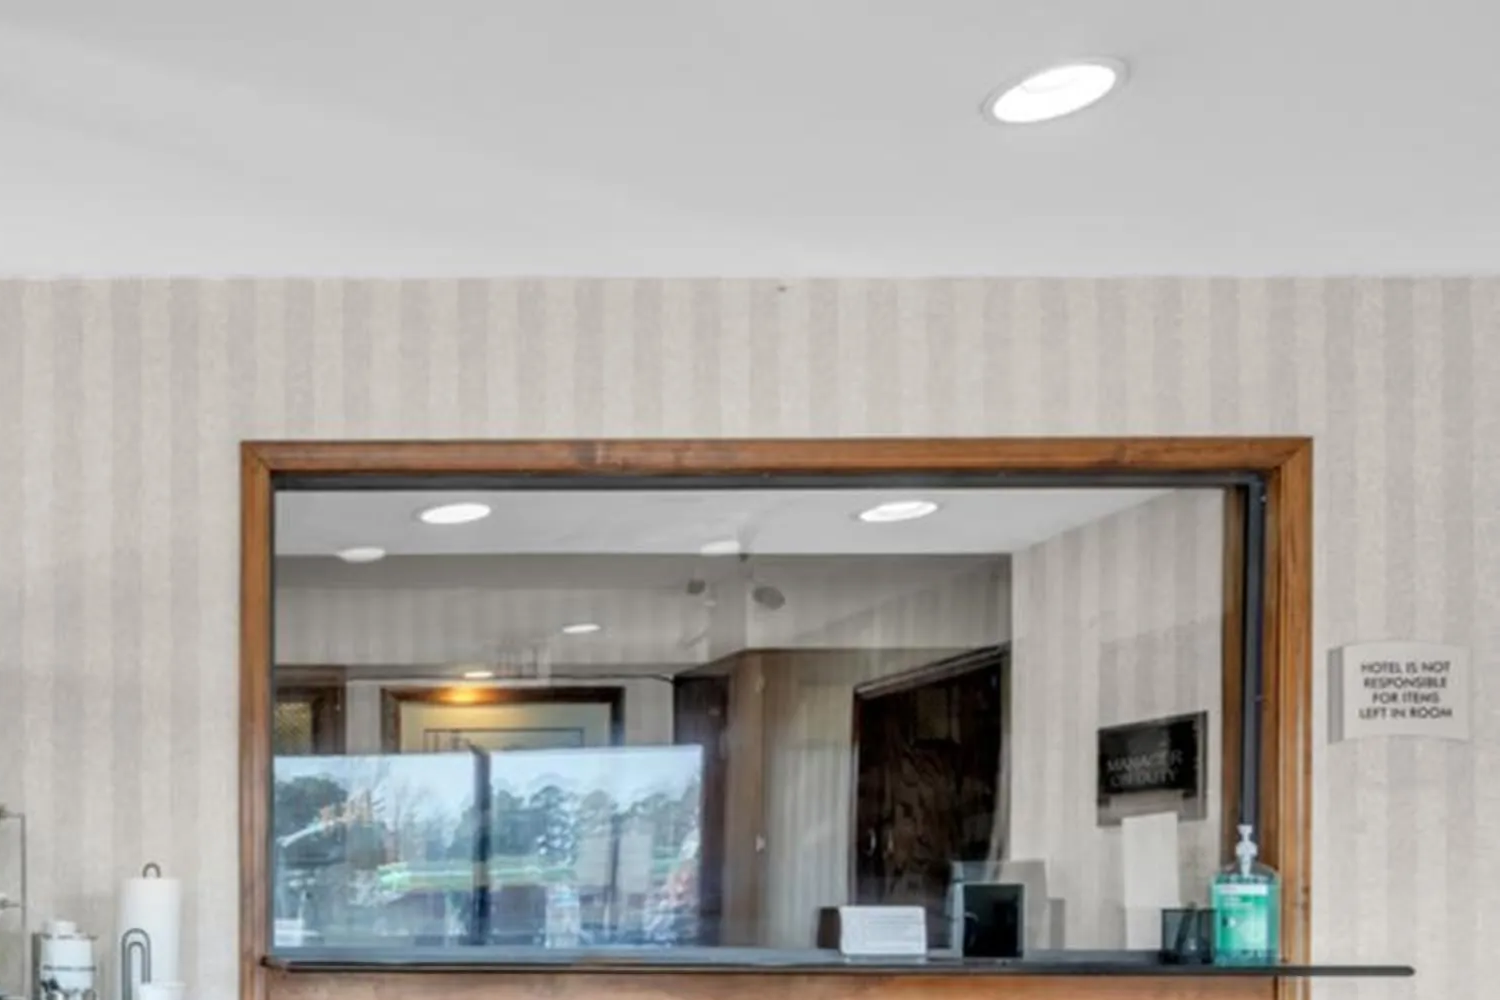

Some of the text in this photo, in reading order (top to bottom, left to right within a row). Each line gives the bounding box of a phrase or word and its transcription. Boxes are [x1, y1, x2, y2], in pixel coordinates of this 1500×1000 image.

[1360, 661, 1451, 674] HOTEL IS NOT
[1363, 676, 1448, 689] RESPONSIBLE
[1372, 691, 1440, 704] FOR ITEMS
[1358, 706, 1453, 720] LEFT IN ROOM
